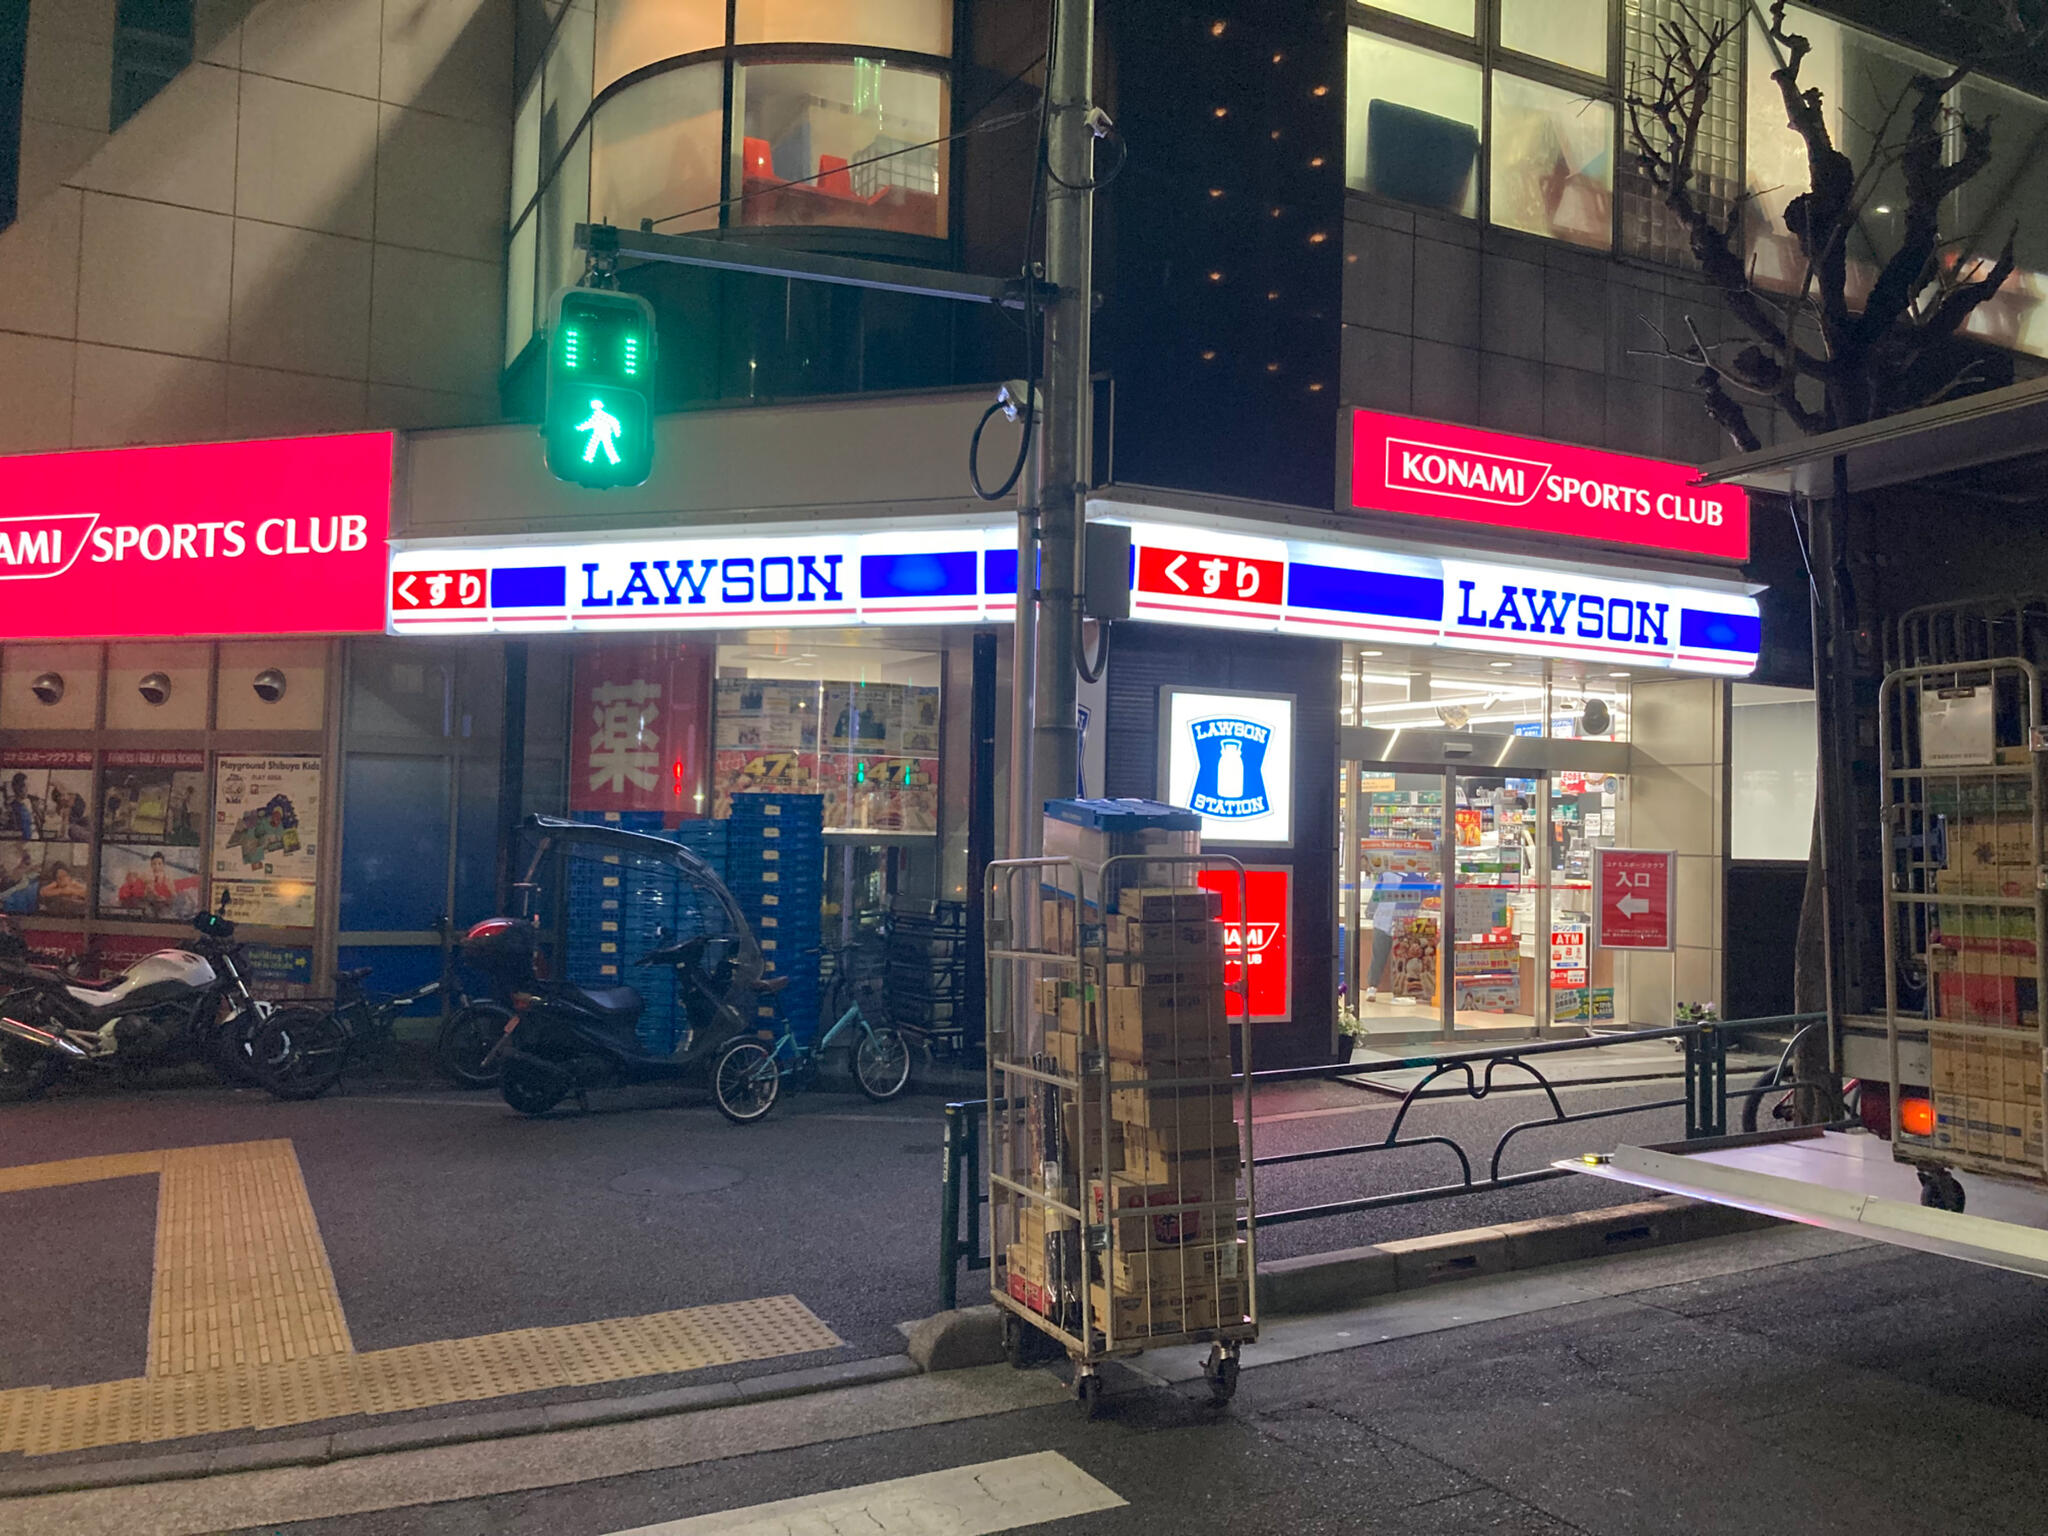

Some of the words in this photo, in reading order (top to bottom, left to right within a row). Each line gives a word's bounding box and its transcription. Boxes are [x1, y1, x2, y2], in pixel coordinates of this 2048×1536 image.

[1402, 451, 1525, 497] KONAMI
[1546, 475, 1651, 516] SPORTS
[1656, 493, 1723, 527] CLUB
[91, 520, 247, 563] SPORTS
[256, 514, 368, 556] CLUB
[398, 573, 482, 607] くすり
[581, 554, 844, 608] LAWSON
[1164, 553, 1261, 598] くすり
[1457, 580, 1669, 646] LAWSON
[589, 679, 662, 793] 薬
[1194, 720, 1267, 744] LAWSON
[220, 761, 265, 771] Playground
[268, 761, 300, 772] Shibuya
[302, 761, 320, 770] Kids
[1194, 793, 1265, 815] STATION
[1616, 871, 1650, 888] 入口
[1556, 934, 1580, 945] ATM
